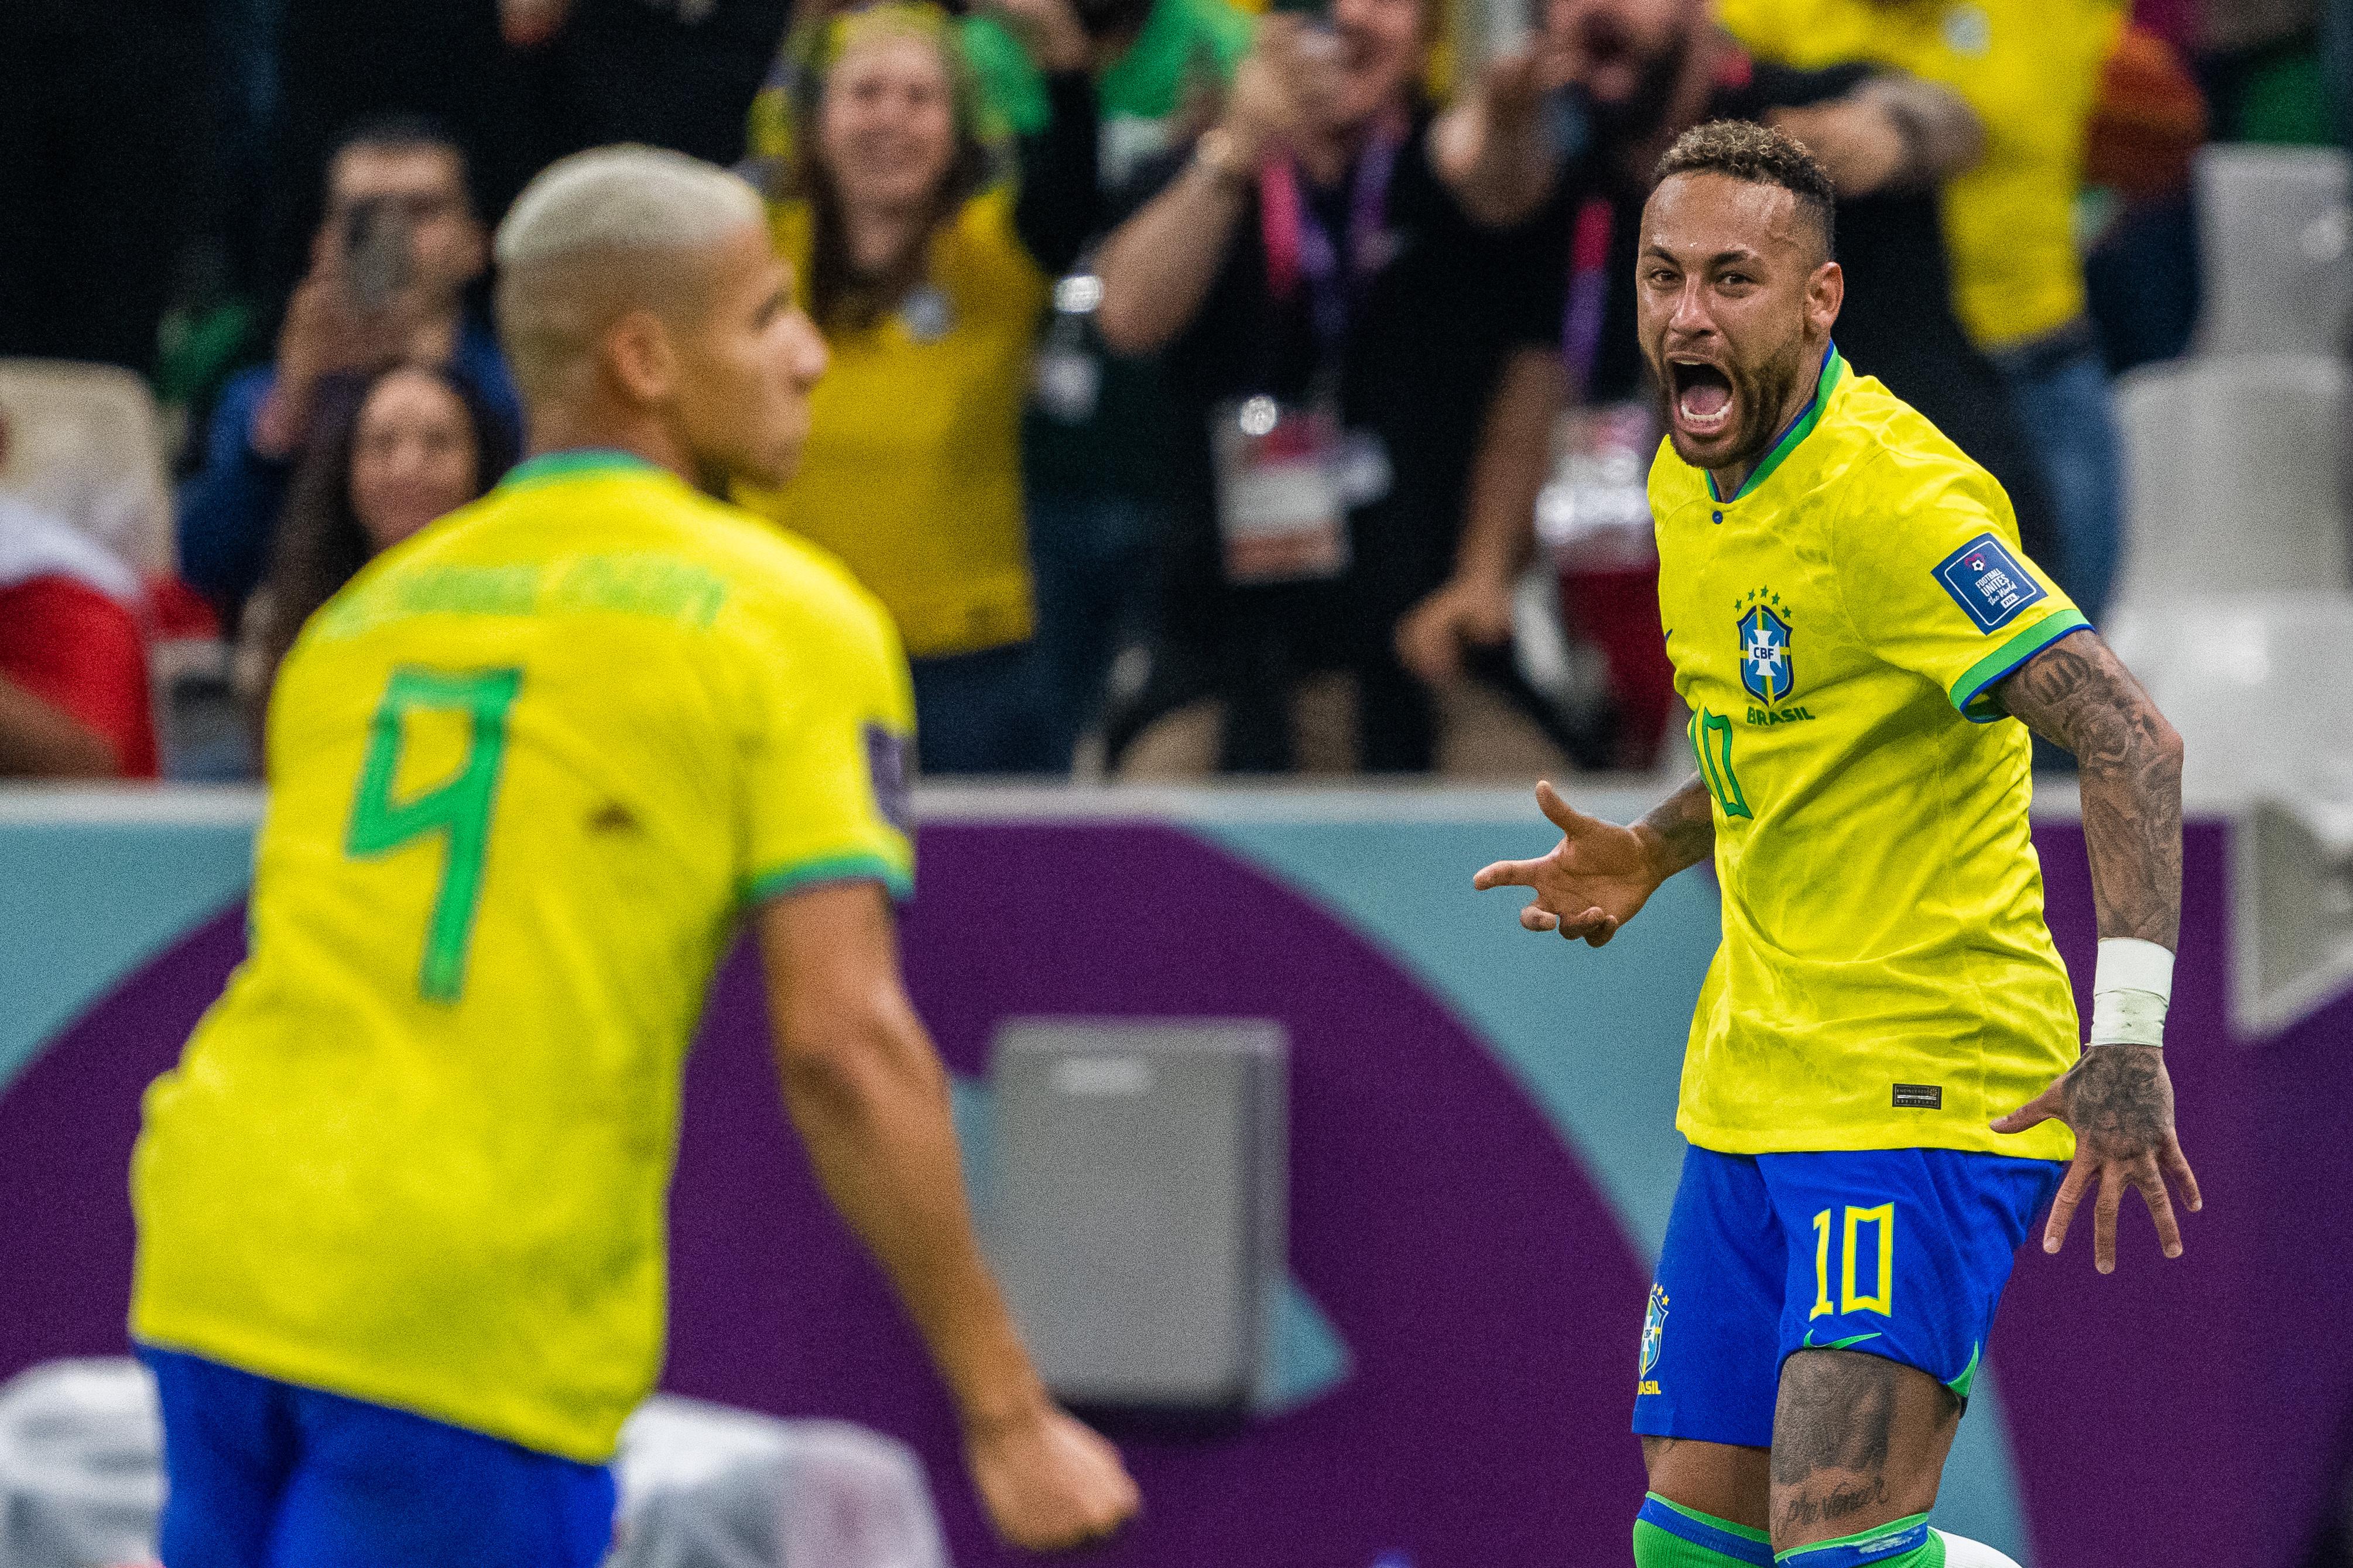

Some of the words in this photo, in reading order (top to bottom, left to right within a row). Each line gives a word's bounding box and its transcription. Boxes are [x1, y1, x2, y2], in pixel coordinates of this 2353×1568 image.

[1975, 568, 2002, 589] FOOTBALL
[1981, 574, 2009, 597] UNITES
[2003, 596, 2016, 606] FIFA
[1753, 647, 1774, 660] CBF
[1746, 706, 1816, 726] BRASIL
[343, 666, 526, 1003] 9
[1809, 1202, 1895, 1322] 10
